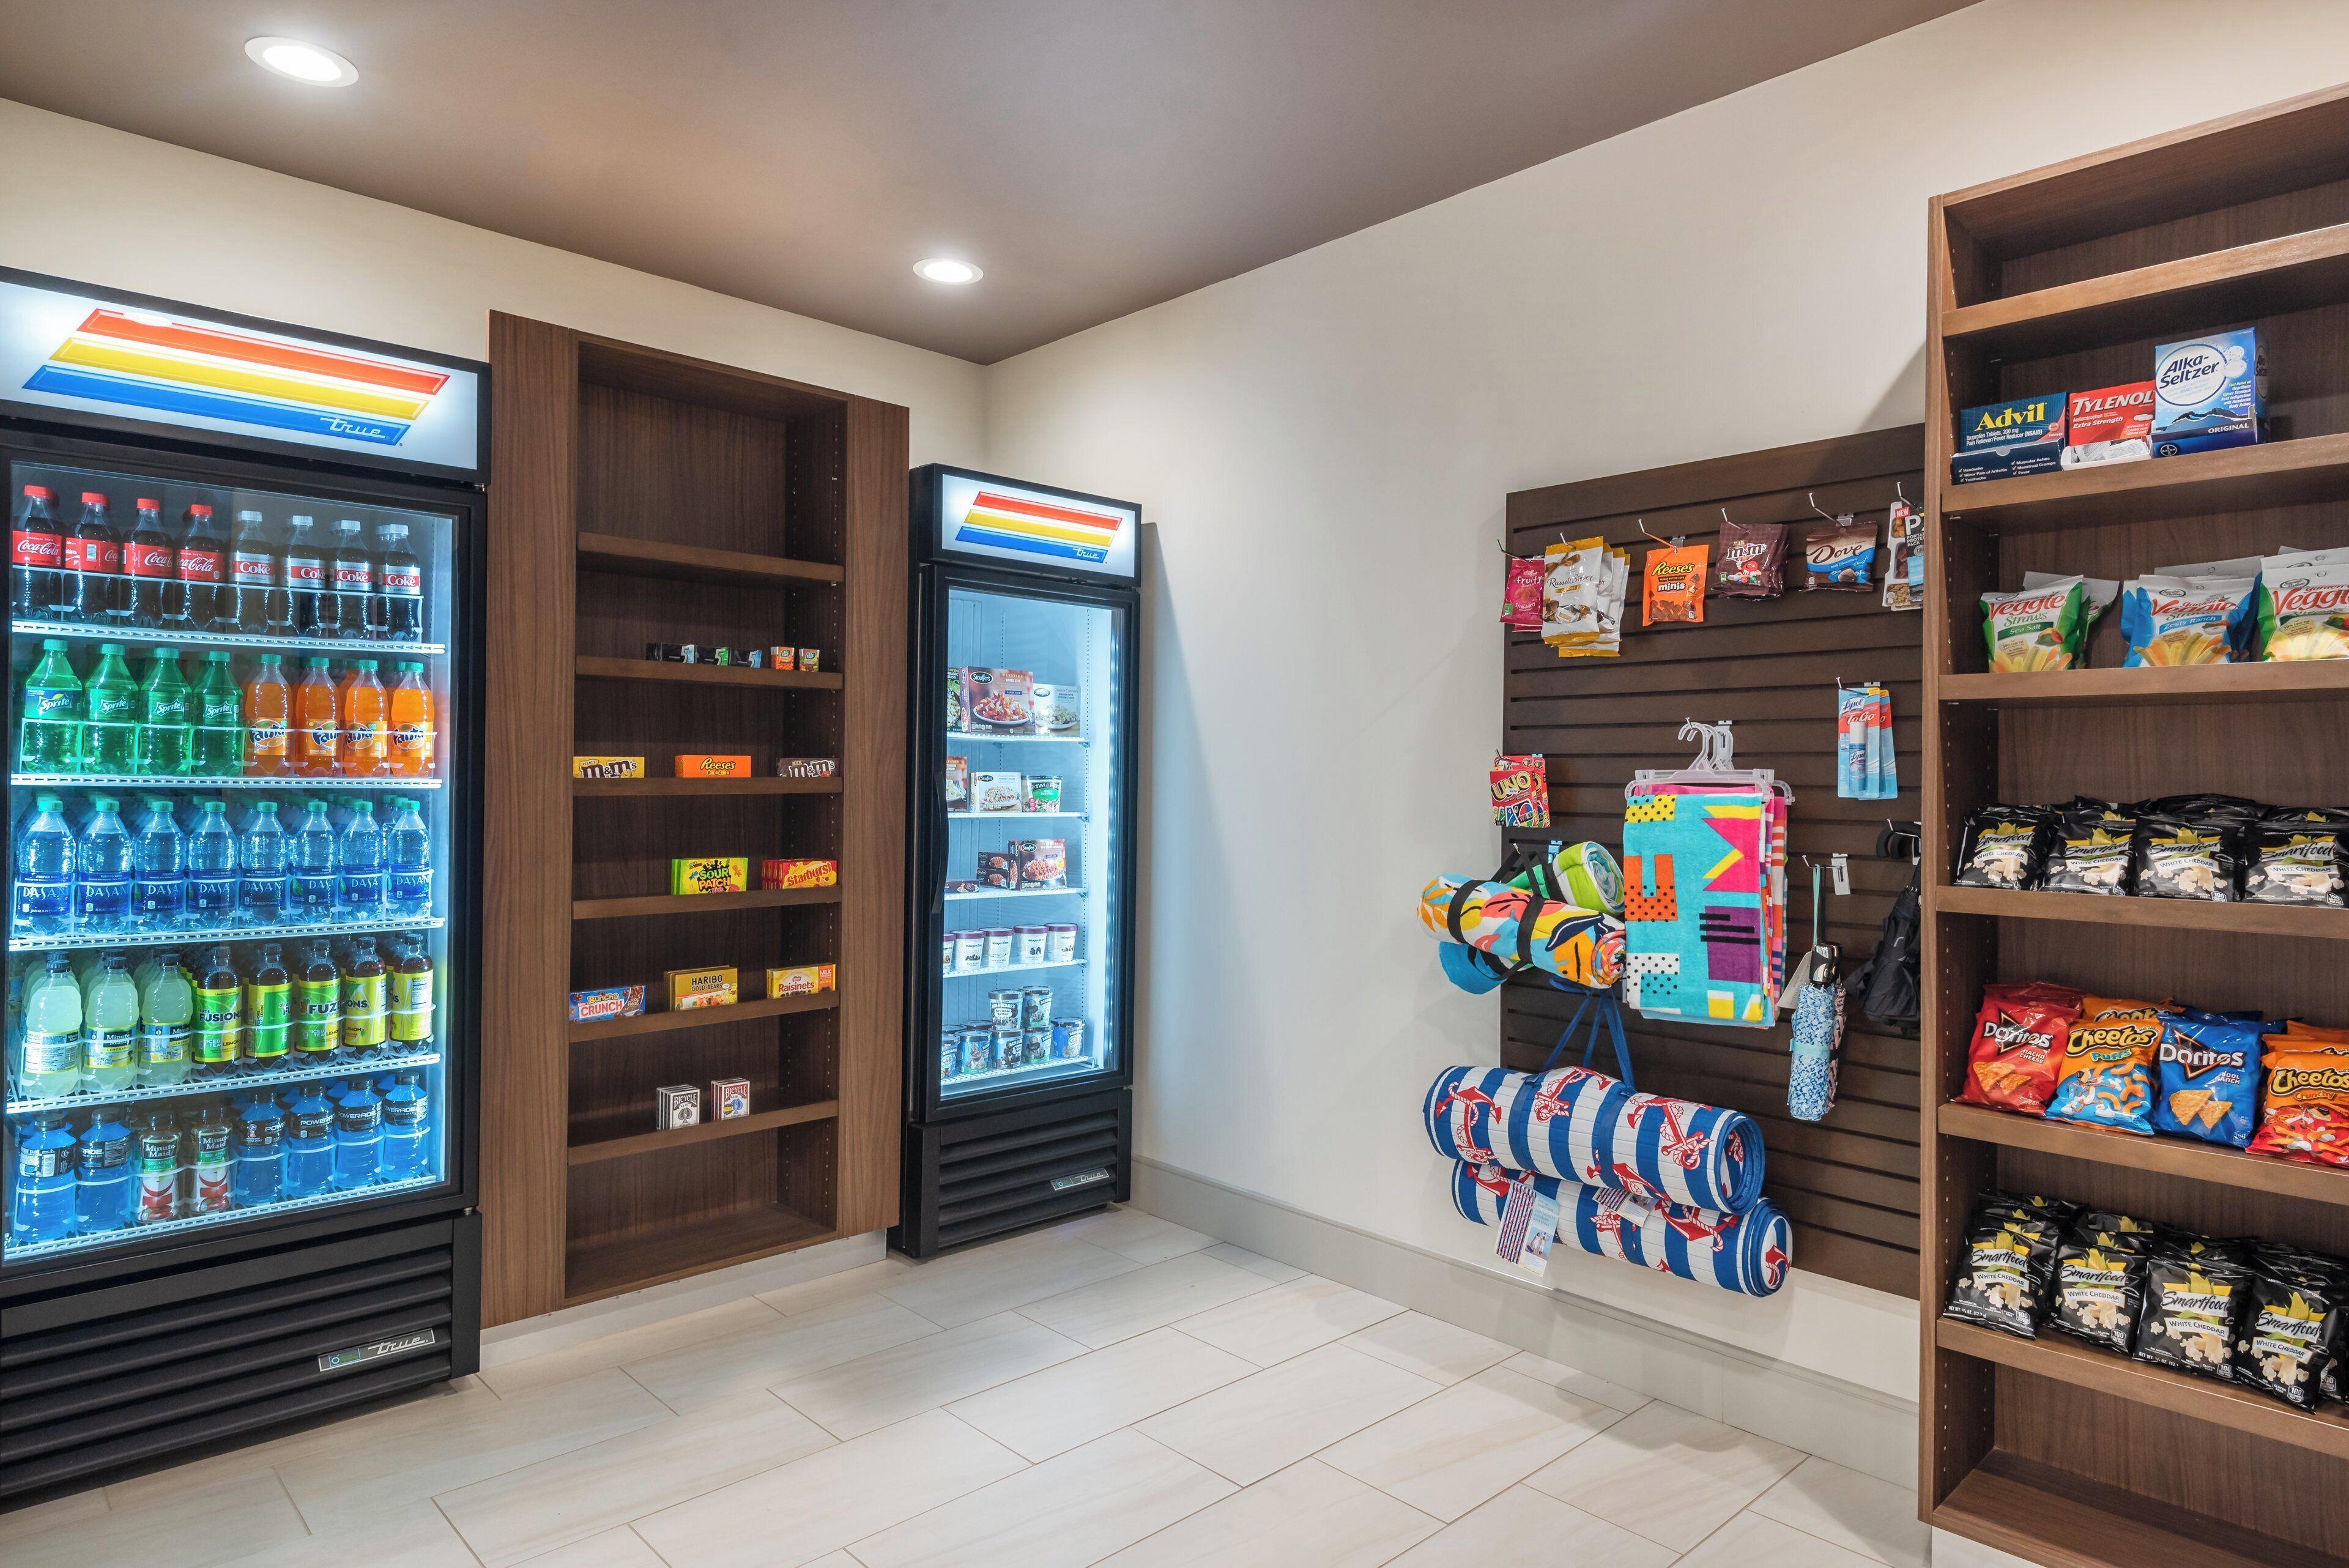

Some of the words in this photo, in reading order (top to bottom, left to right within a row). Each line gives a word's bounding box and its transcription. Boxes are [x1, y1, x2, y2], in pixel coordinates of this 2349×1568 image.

[2162, 354, 2209, 377] Alka-
[2159, 361, 2220, 390] Seltzer
[2072, 390, 2154, 417] TYLENOL
[1974, 402, 2045, 431] Advil
[2073, 414, 2103, 423] Acetaminophen
[2092, 416, 2123, 426] Strength
[319, 417, 386, 439] true
[2024, 428, 2043, 437] (NSAID)
[2208, 423, 2249, 434] ORIGINAL
[1966, 432, 1986, 441] Ibuprofen
[1896, 508, 1909, 518] NEW
[17, 540, 59, 556] Coca-Cola
[240, 562, 270, 574] Coke
[300, 568, 325, 579] Coke
[1652, 562, 1695, 576] Reese's
[339, 570, 368, 582] Coke
[387, 574, 416, 586] Coke
[1657, 581, 1686, 592] minis
[1989, 593, 2066, 622] Veggie
[2003, 611, 2048, 627] Straws
[2163, 620, 2187, 631] Zesty
[2190, 615, 2216, 624] Ranch
[40, 697, 70, 711] Sprite
[101, 699, 127, 712] Sprite
[157, 702, 181, 714] Sprite
[207, 704, 230, 716] Sprite
[1842, 697, 1863, 710] Lysol
[1859, 711, 1875, 723] Go
[700, 757, 736, 770] Reese's
[1491, 771, 1532, 802] UNO
[699, 868, 729, 880] SOUR
[787, 861, 833, 886] Starburst
[698, 877, 730, 891] PATCH
[691, 974, 722, 986] HARIBO
[778, 981, 815, 993] Raisinets
[587, 992, 619, 1005] Buncha
[580, 1000, 623, 1017] CRUNCH
[1983, 1022, 2055, 1050] Doritos
[2067, 1025, 2155, 1053] Cheetos
[2159, 1042, 2246, 1068] Doritos
[725, 1085, 748, 1100] BICYCLE
[2293, 1091, 2336, 1101] Crunchy
[674, 1093, 697, 1107] BICYCLE
[1970, 1249, 2028, 1268] Smartfood
[2060, 1265, 2127, 1283] Smartfood
[2161, 1290, 2230, 1312] Smartfood
[2256, 1312, 2320, 1337] Smartfood
[368, 1336, 429, 1354] true
[2255, 1339, 2277, 1349] WHITE
[2290, 1386, 2302, 1397] 100
